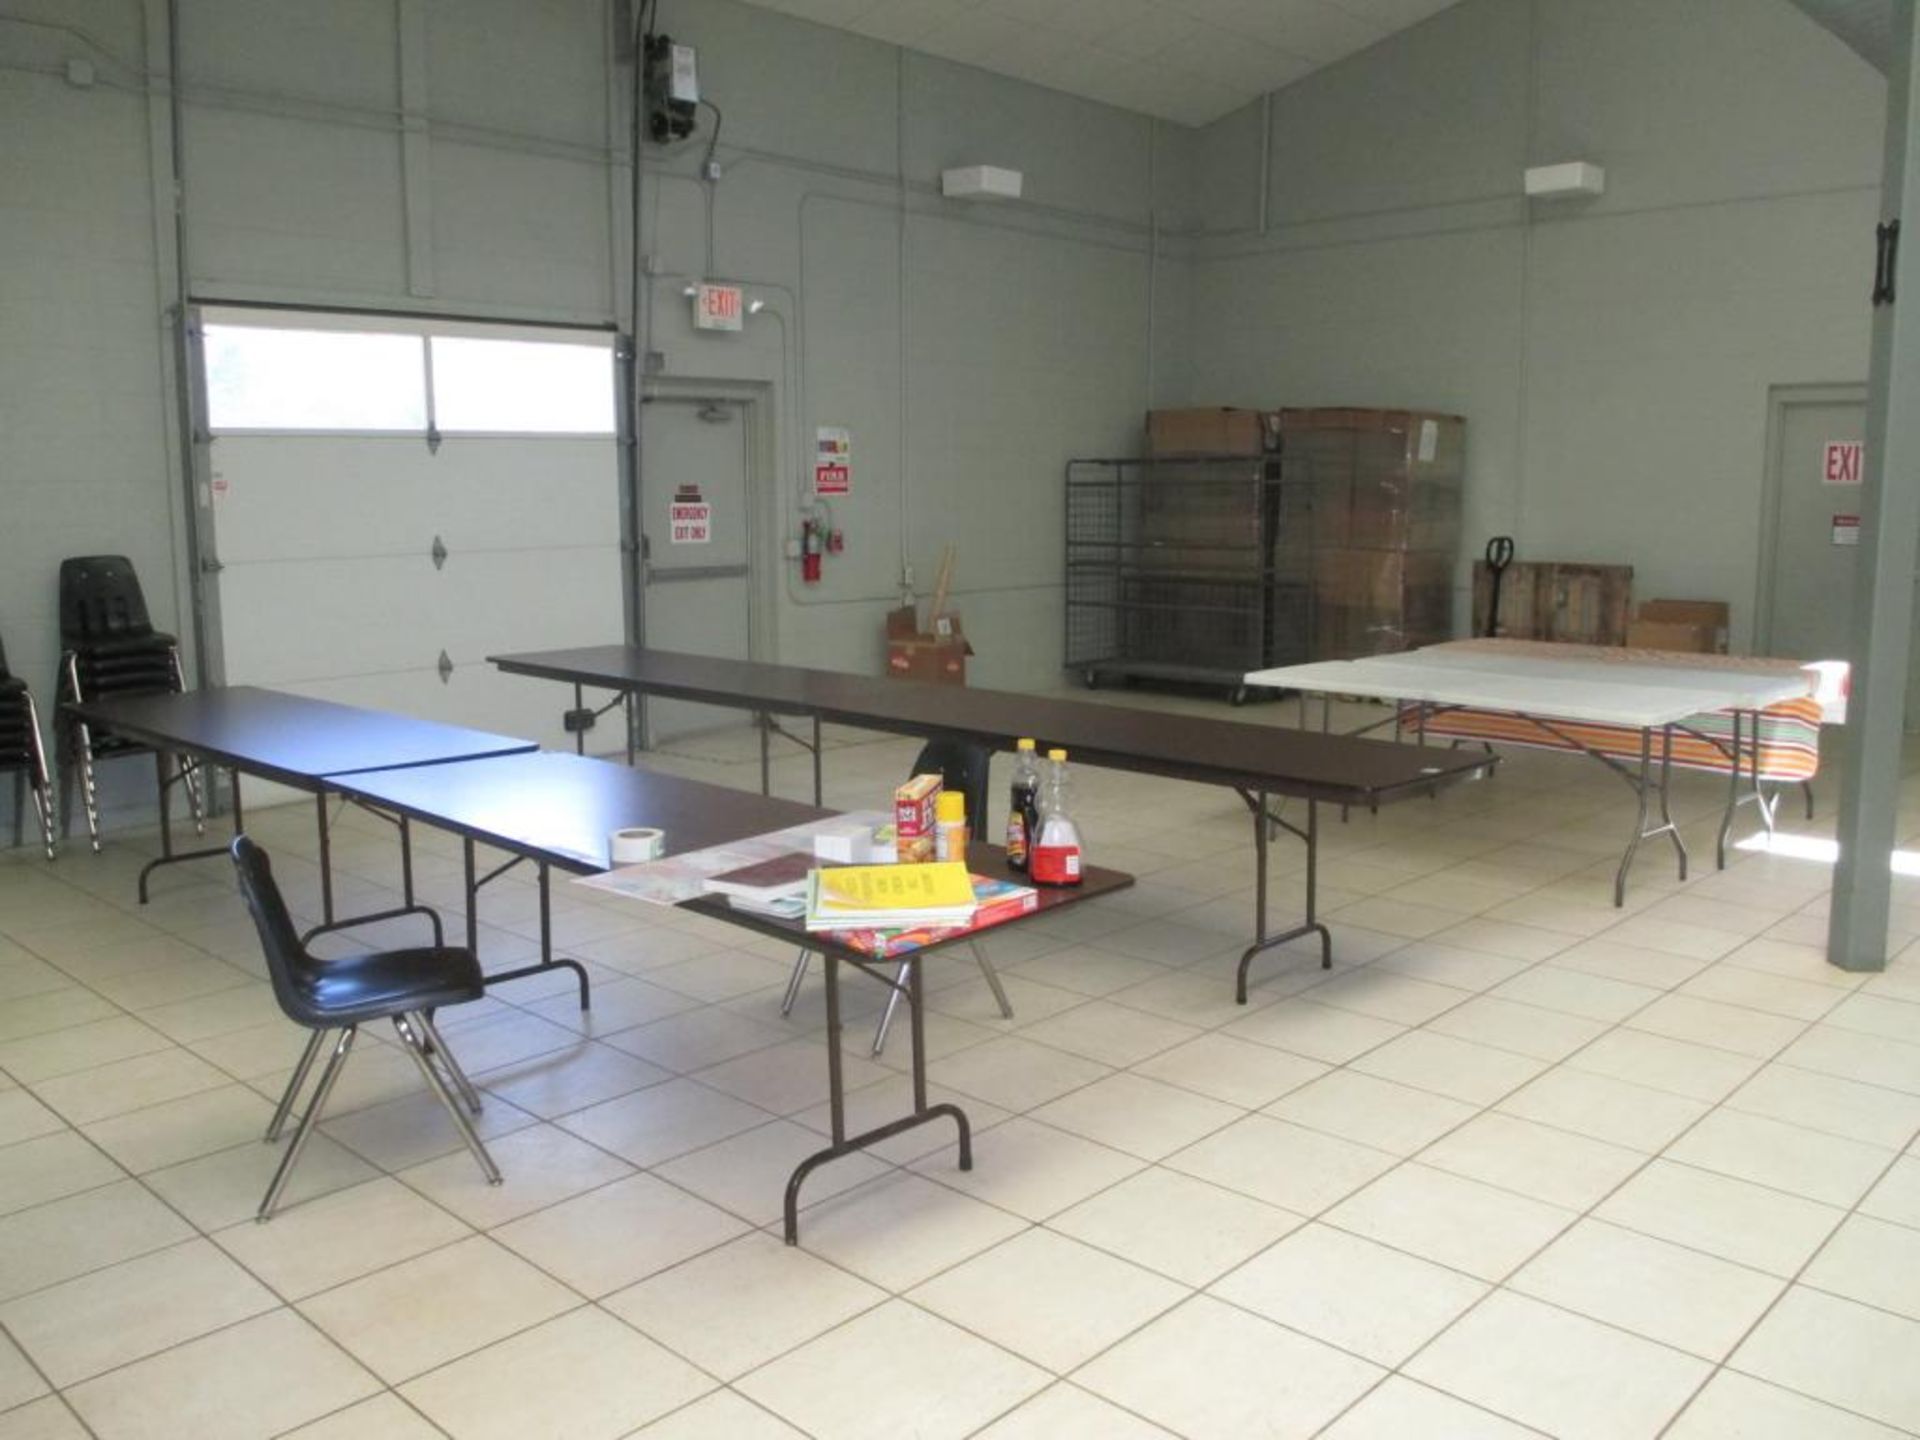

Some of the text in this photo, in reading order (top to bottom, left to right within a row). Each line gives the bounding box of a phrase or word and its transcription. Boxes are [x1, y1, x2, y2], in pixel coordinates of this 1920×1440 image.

[708, 289, 736, 317] EXIT
[1827, 445, 1861, 481] EXI
[672, 506, 708, 520] EMERGENCY
[674, 526, 706, 540] EXIT ONLY
